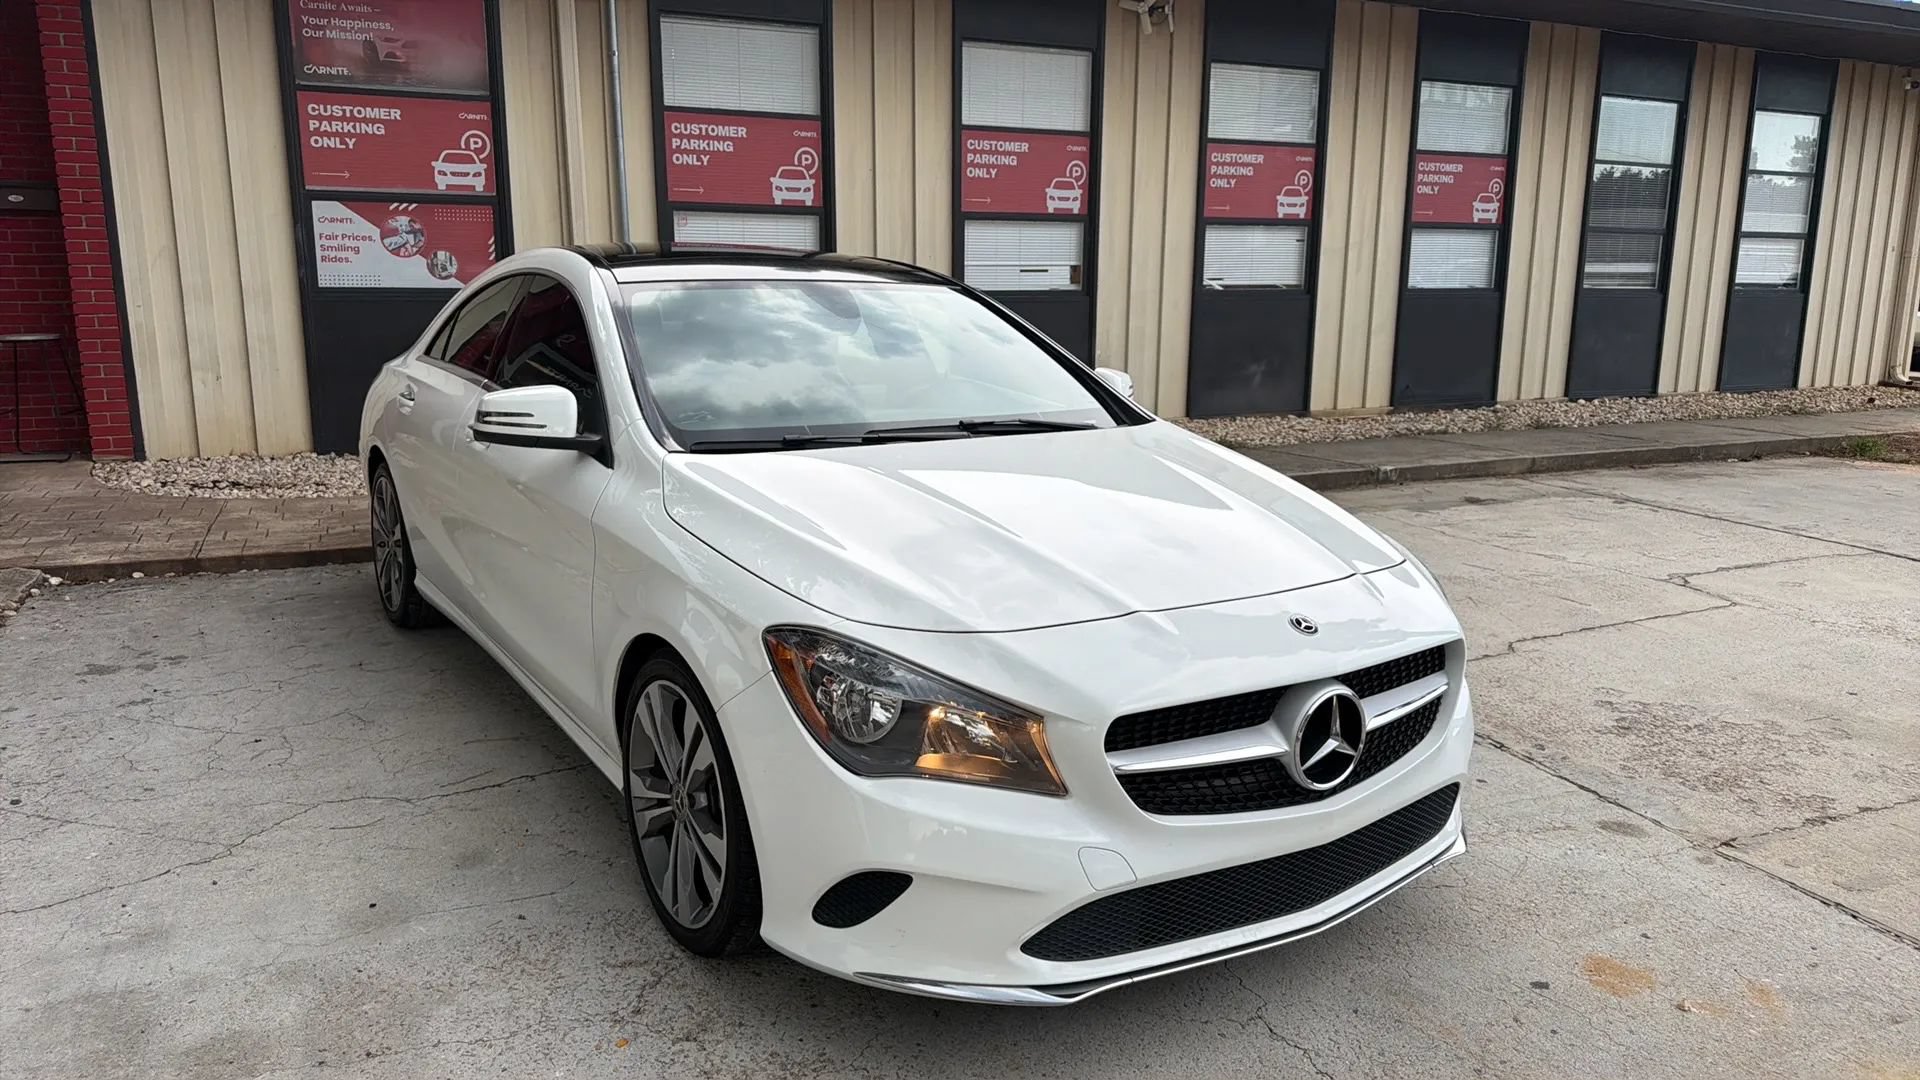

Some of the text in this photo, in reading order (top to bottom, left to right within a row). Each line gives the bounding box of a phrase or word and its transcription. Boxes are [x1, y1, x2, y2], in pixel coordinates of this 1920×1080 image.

[300, 0, 337, 11] Carnite
[339, 1, 373, 13] Awaits
[301, 15, 394, 32] Your Happiness,
[302, 28, 374, 41] Our Mission!
[307, 104, 401, 120] CUSTOMER
[309, 120, 385, 135] PARKING
[671, 123, 747, 138] CUSTOMER
[310, 136, 356, 149] ONLY
[672, 138, 734, 152] PARKING
[967, 139, 1029, 152] CUSTOMER
[672, 154, 710, 166] ONLY
[967, 154, 1017, 166] PARKING
[1211, 152, 1264, 164] CUSTOMER
[966, 167, 997, 178] ONLY
[1211, 165, 1254, 176] PARKING
[1418, 162, 1463, 173] CUSTOMER
[1210, 178, 1236, 187] ONLY
[1417, 173, 1454, 183] PARKING
[1416, 185, 1439, 194] ONLY
[319, 232, 376, 243] Fair Prices,
[320, 244, 360, 255] Smiling
[321, 255, 352, 263] Rides.
